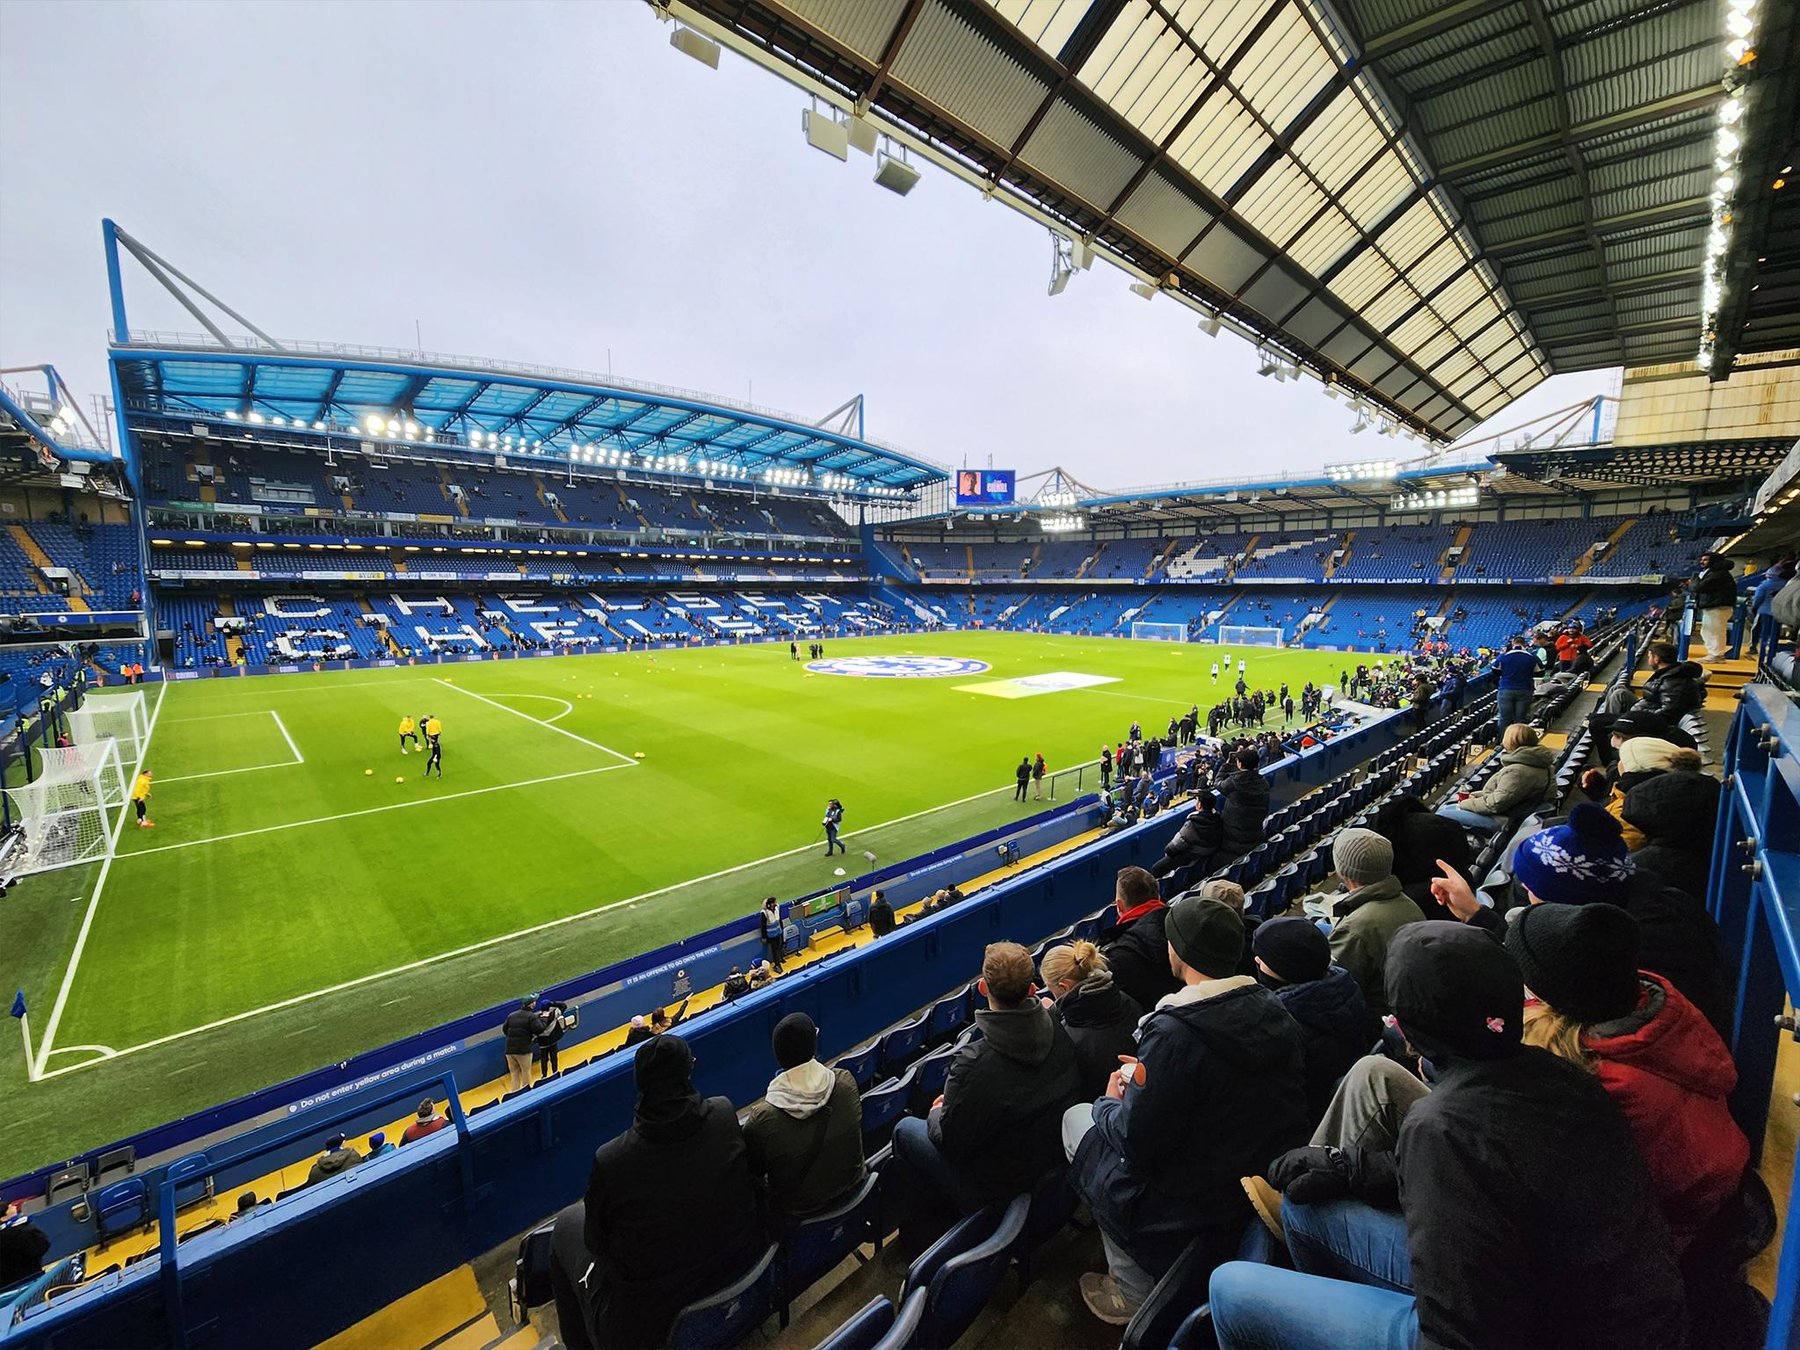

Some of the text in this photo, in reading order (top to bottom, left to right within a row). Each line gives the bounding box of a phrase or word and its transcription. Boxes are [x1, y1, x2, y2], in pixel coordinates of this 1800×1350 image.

[646, 966, 668, 977] OFFENCE
[682, 955, 696, 964] ONTO
[695, 951, 705, 959] THE
[704, 947, 718, 956] PITCH
[300, 1099, 314, 1108] Do
[315, 1093, 330, 1103] not
[331, 1085, 353, 1097] enter
[354, 1075, 380, 1090] yellow
[381, 1067, 400, 1078] area
[400, 1056, 426, 1071] during
[433, 1045, 457, 1058] match
